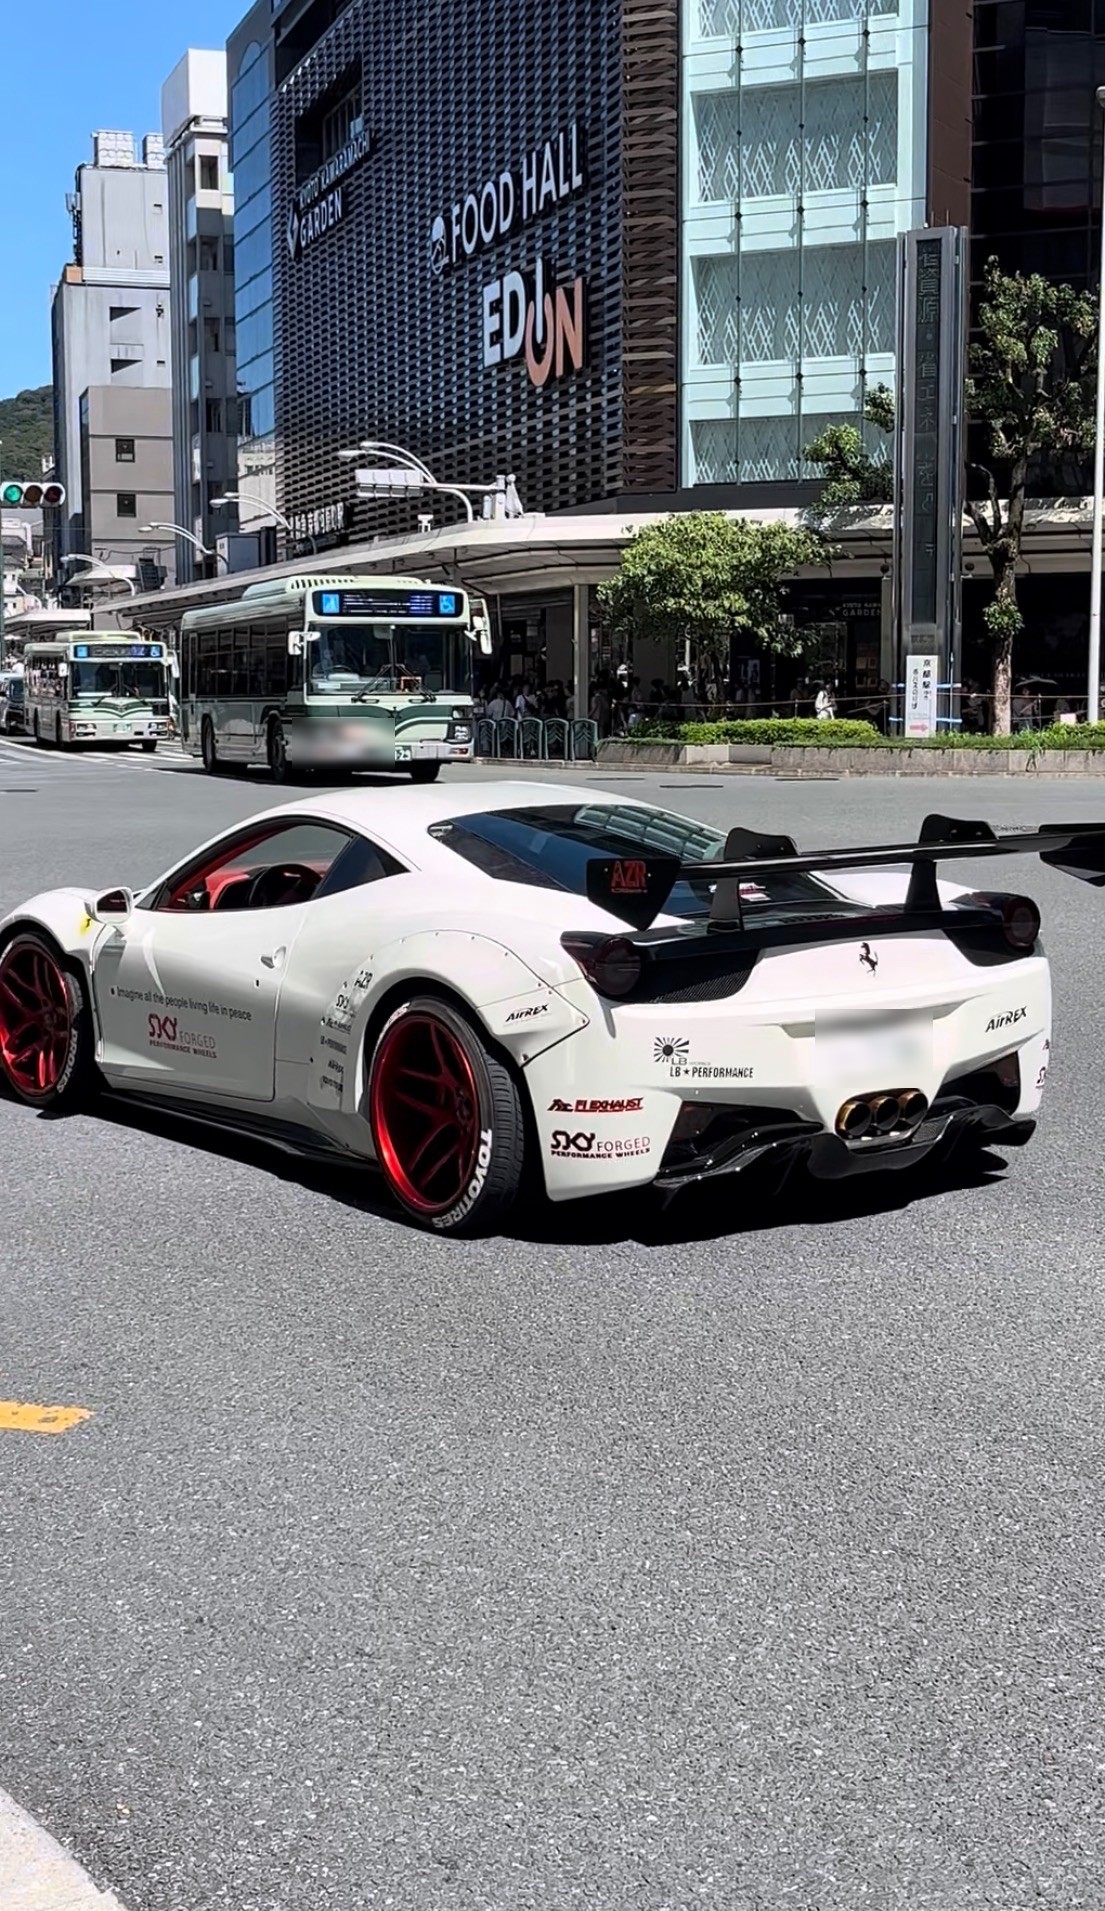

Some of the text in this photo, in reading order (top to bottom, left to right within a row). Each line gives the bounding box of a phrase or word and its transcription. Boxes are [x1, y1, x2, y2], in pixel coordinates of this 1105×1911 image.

[452, 122, 583, 262] FOOD HALL
[300, 187, 342, 248] GARDEN
[483, 258, 583, 387] EDION
[611, 860, 647, 888] AZR
[117, 986, 252, 1021] Imagine all the people living life in peace
[148, 1013, 216, 1049] SKY FORGED
[669, 1066, 754, 1078] LB PERFORMANCE
[589, 1097, 644, 1112] EXHAUST
[550, 1130, 651, 1152] SKY FORGED
[551, 1147, 651, 1159] PERFORMANCE WHEELS
[432, 1128, 493, 1229] TOYO TIRES
